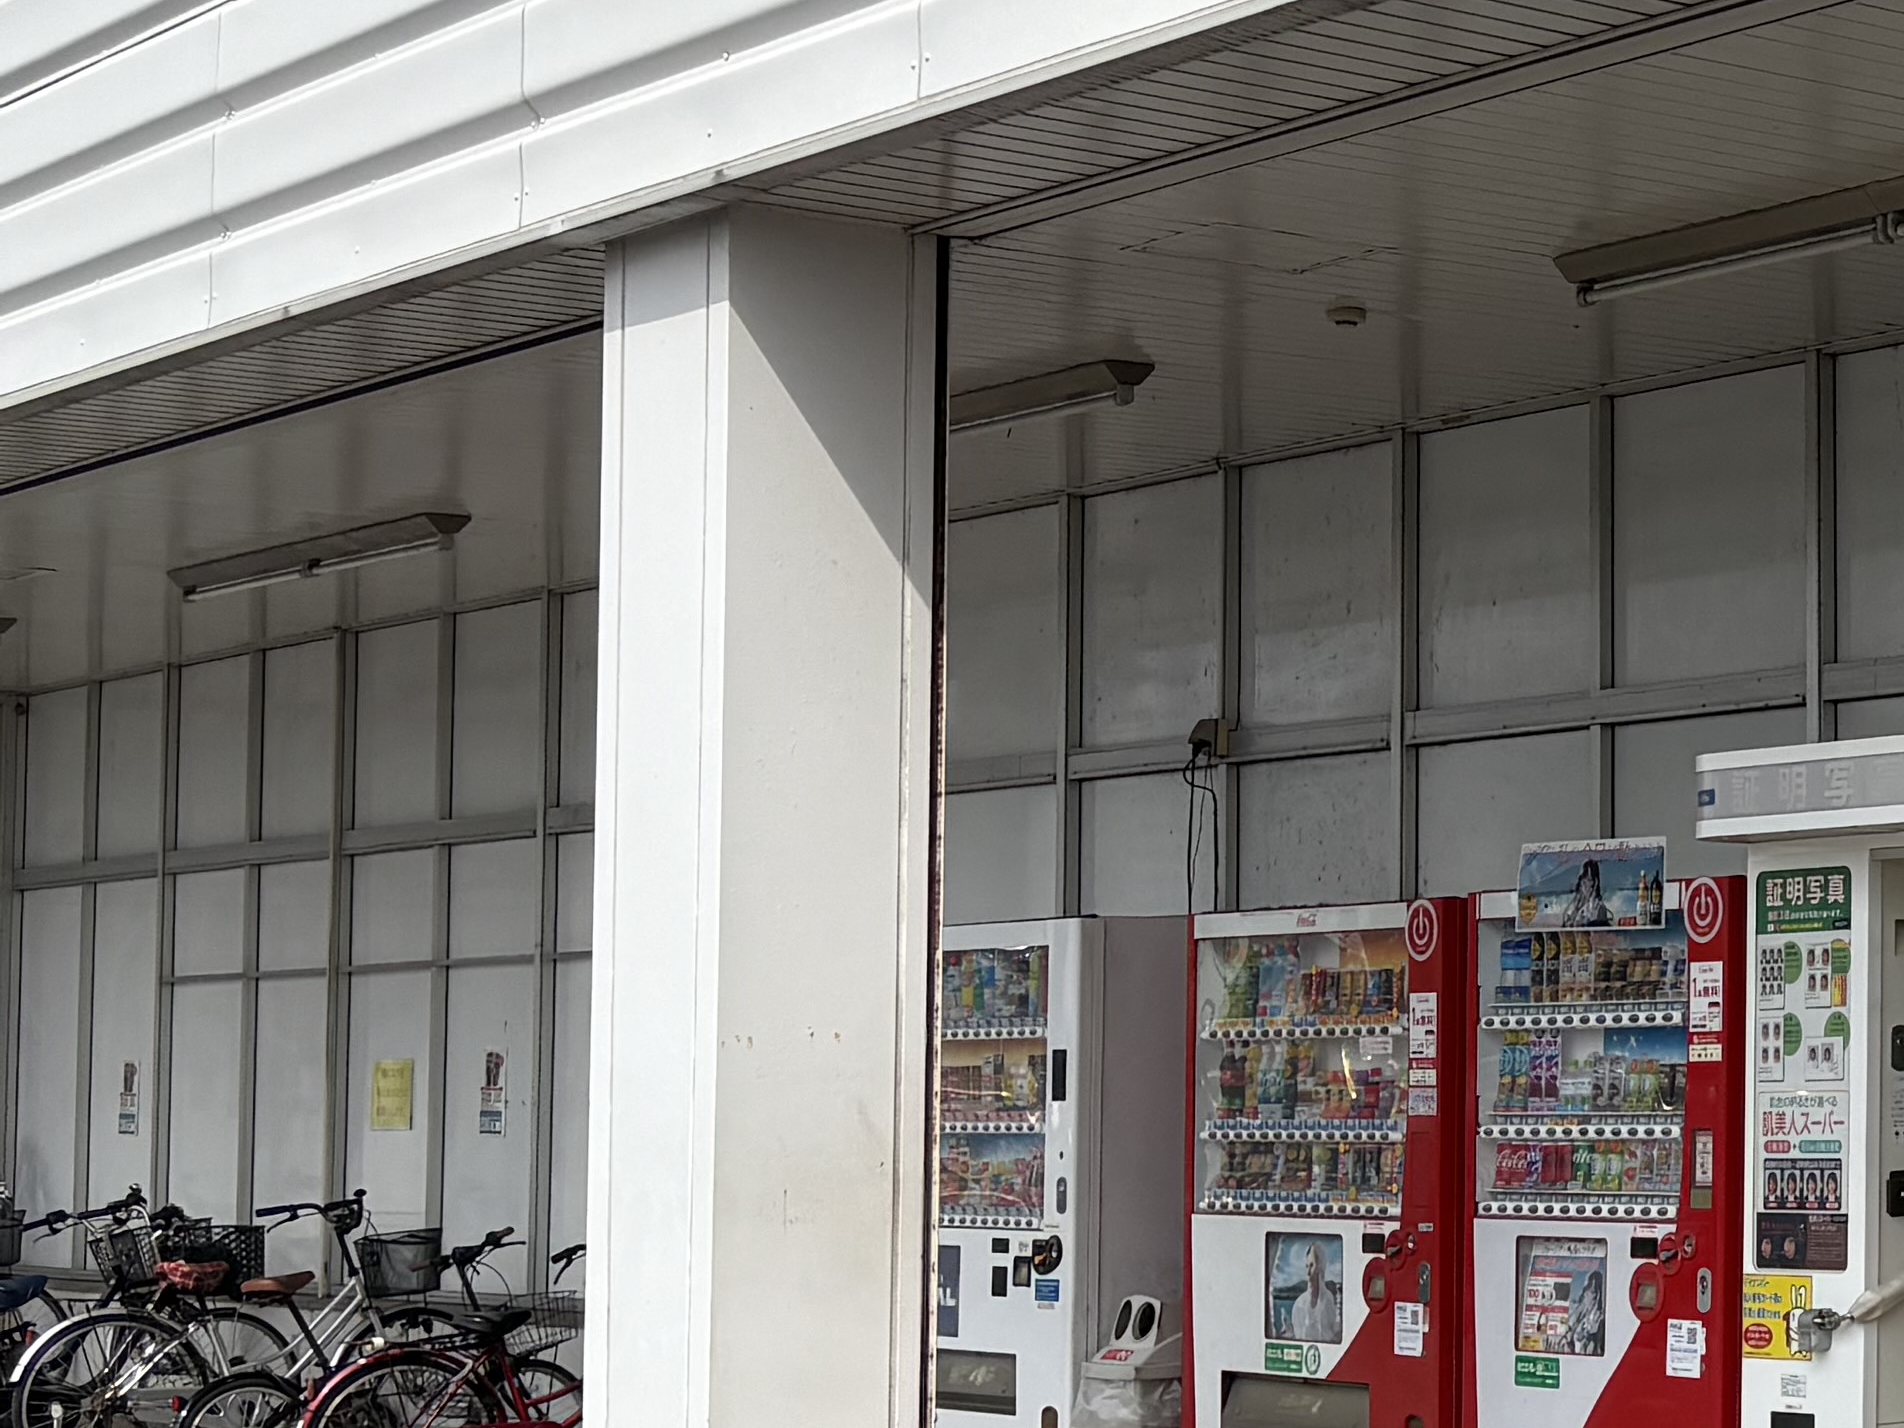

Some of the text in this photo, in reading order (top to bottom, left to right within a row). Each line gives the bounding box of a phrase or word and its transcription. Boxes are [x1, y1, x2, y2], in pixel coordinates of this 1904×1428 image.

[1765, 874, 1845, 907] 証明写真
[1762, 1110, 1845, 1137] 肌美人スーパー
